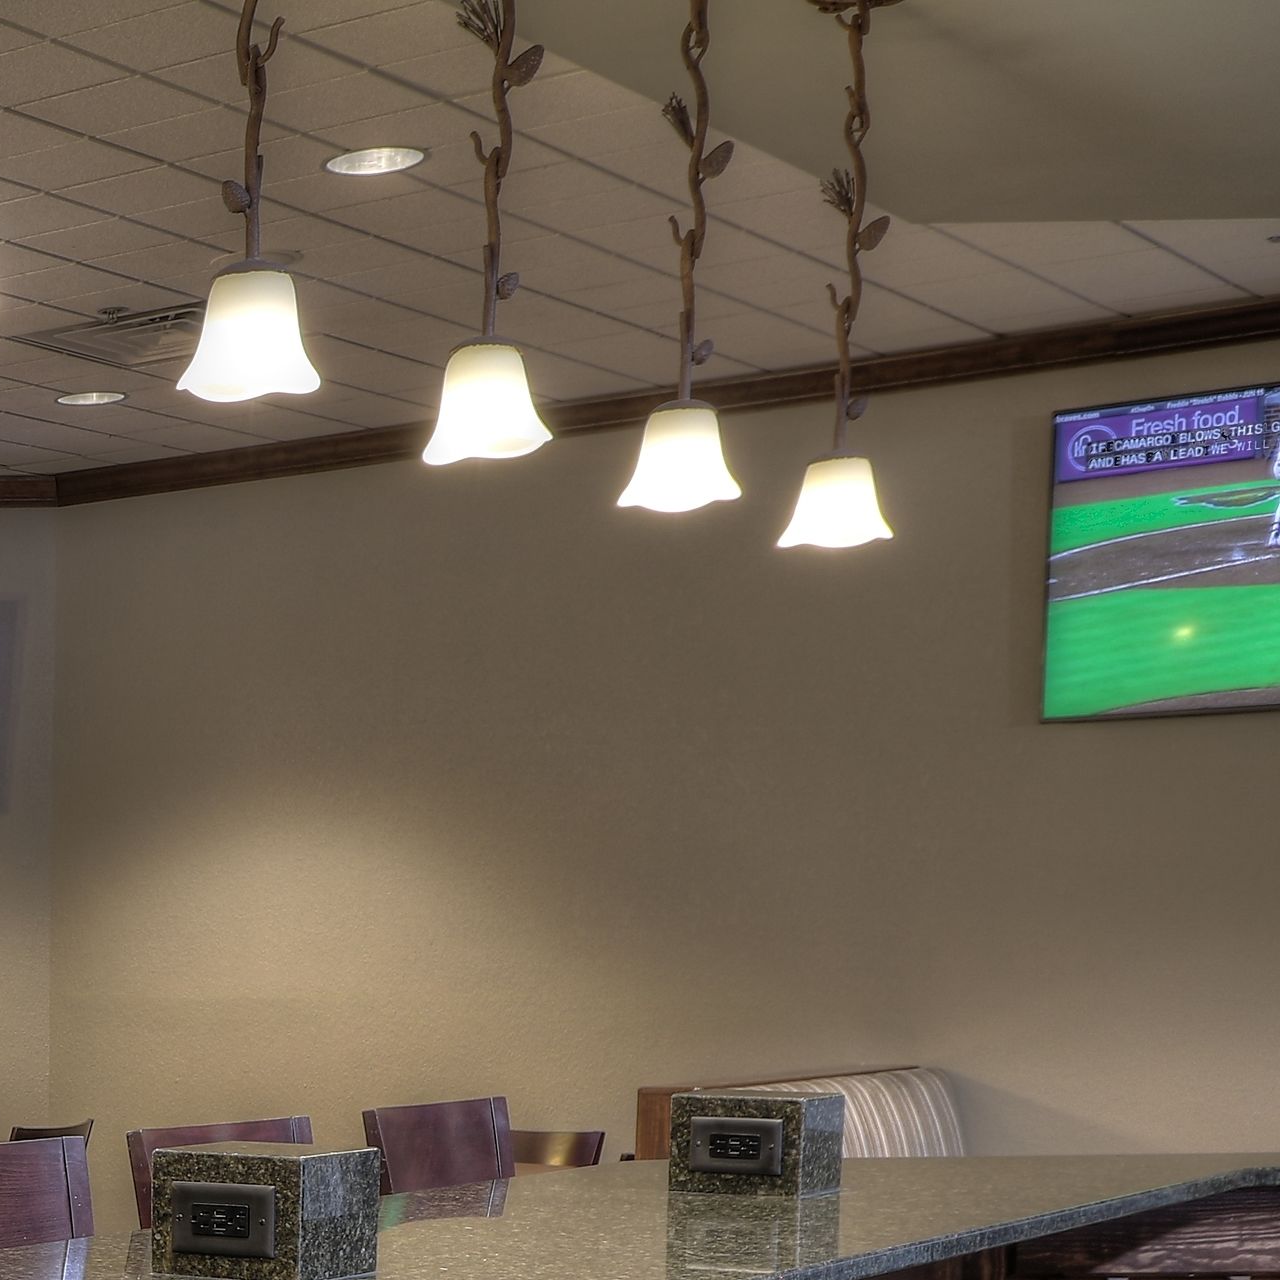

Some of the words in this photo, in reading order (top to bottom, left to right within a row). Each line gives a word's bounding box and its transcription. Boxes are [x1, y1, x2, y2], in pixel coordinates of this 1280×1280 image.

[1131, 413, 1186, 436] Fresh
[1192, 405, 1244, 429] food.
[1114, 435, 1171, 451] CAMARGO
[1180, 429, 1220, 443] BLOWS
[1230, 424, 1263, 437] THIS
[1088, 457, 1114, 469] AND
[1121, 453, 1147, 465] HAS
[1153, 451, 1163, 461] A
[1170, 446, 1204, 460] LEAD
[1211, 443, 1228, 454] WE
[1237, 440, 1269, 452] WILL
